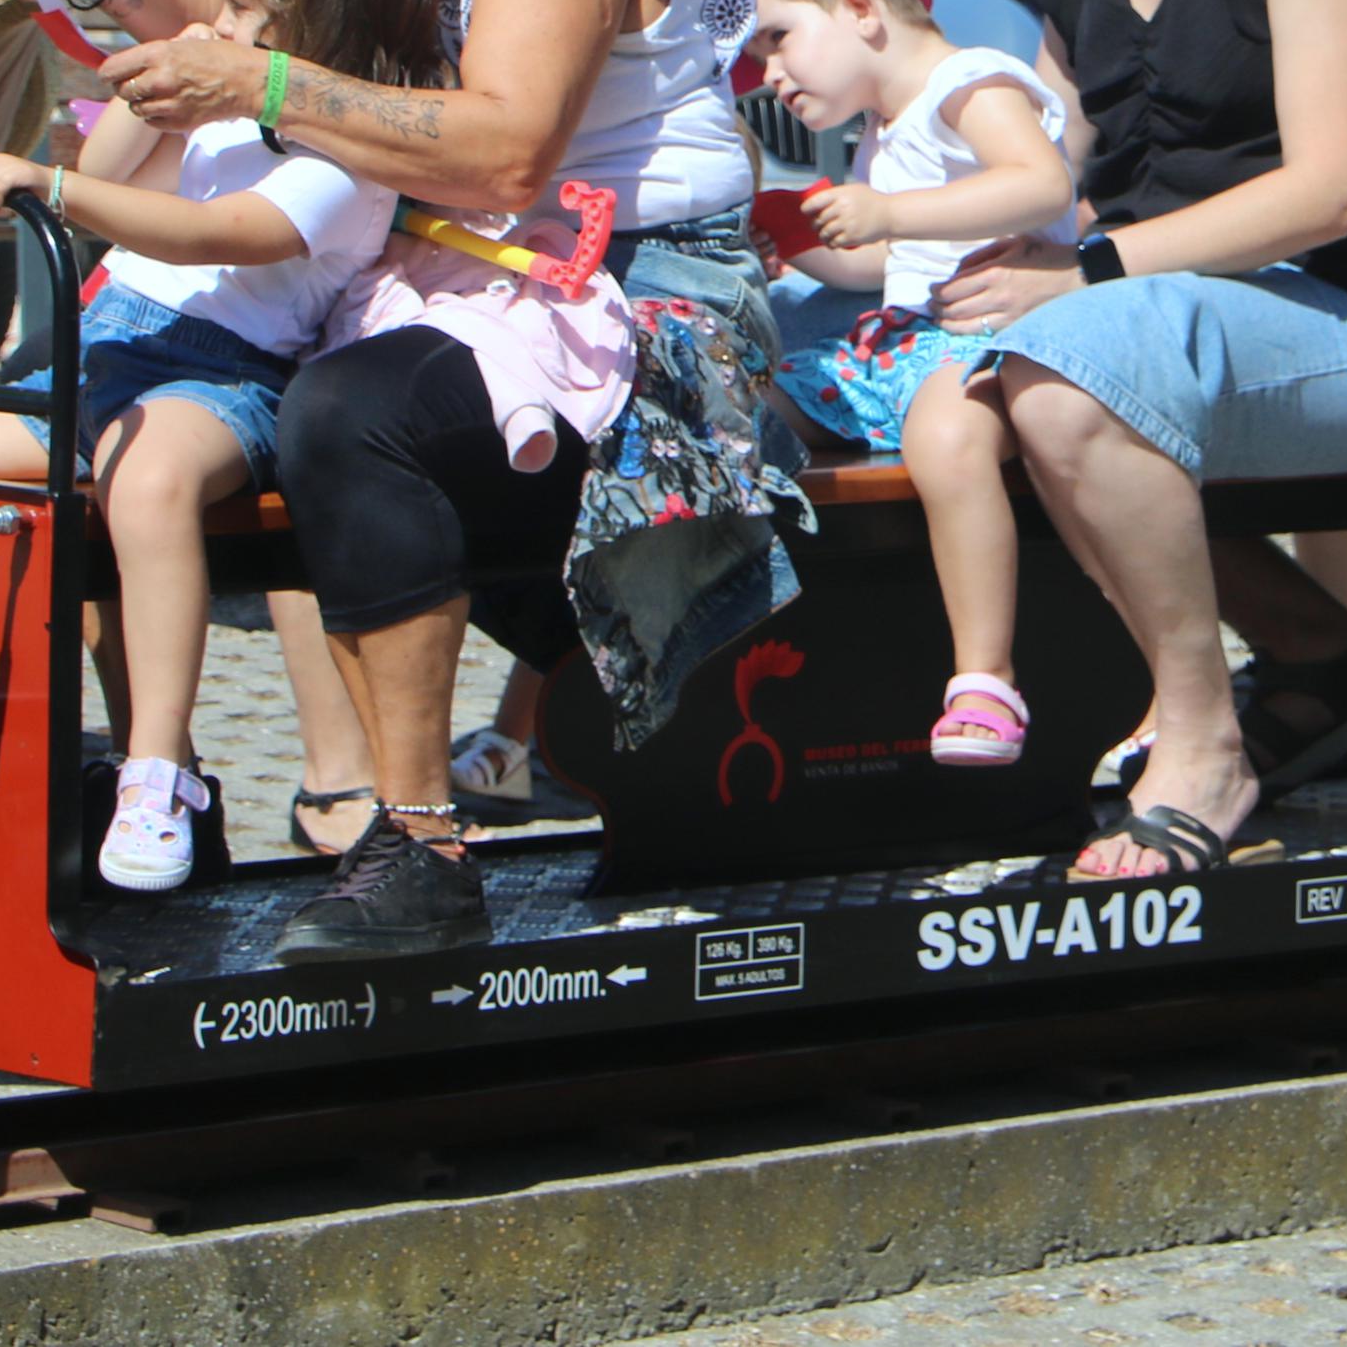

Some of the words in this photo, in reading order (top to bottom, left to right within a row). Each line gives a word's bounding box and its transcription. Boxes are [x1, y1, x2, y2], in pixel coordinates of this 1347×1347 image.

[1307, 885, 1345, 913] REV
[917, 884, 1203, 972] SSV-A102
[478, 965, 607, 1011] 2000mm.
